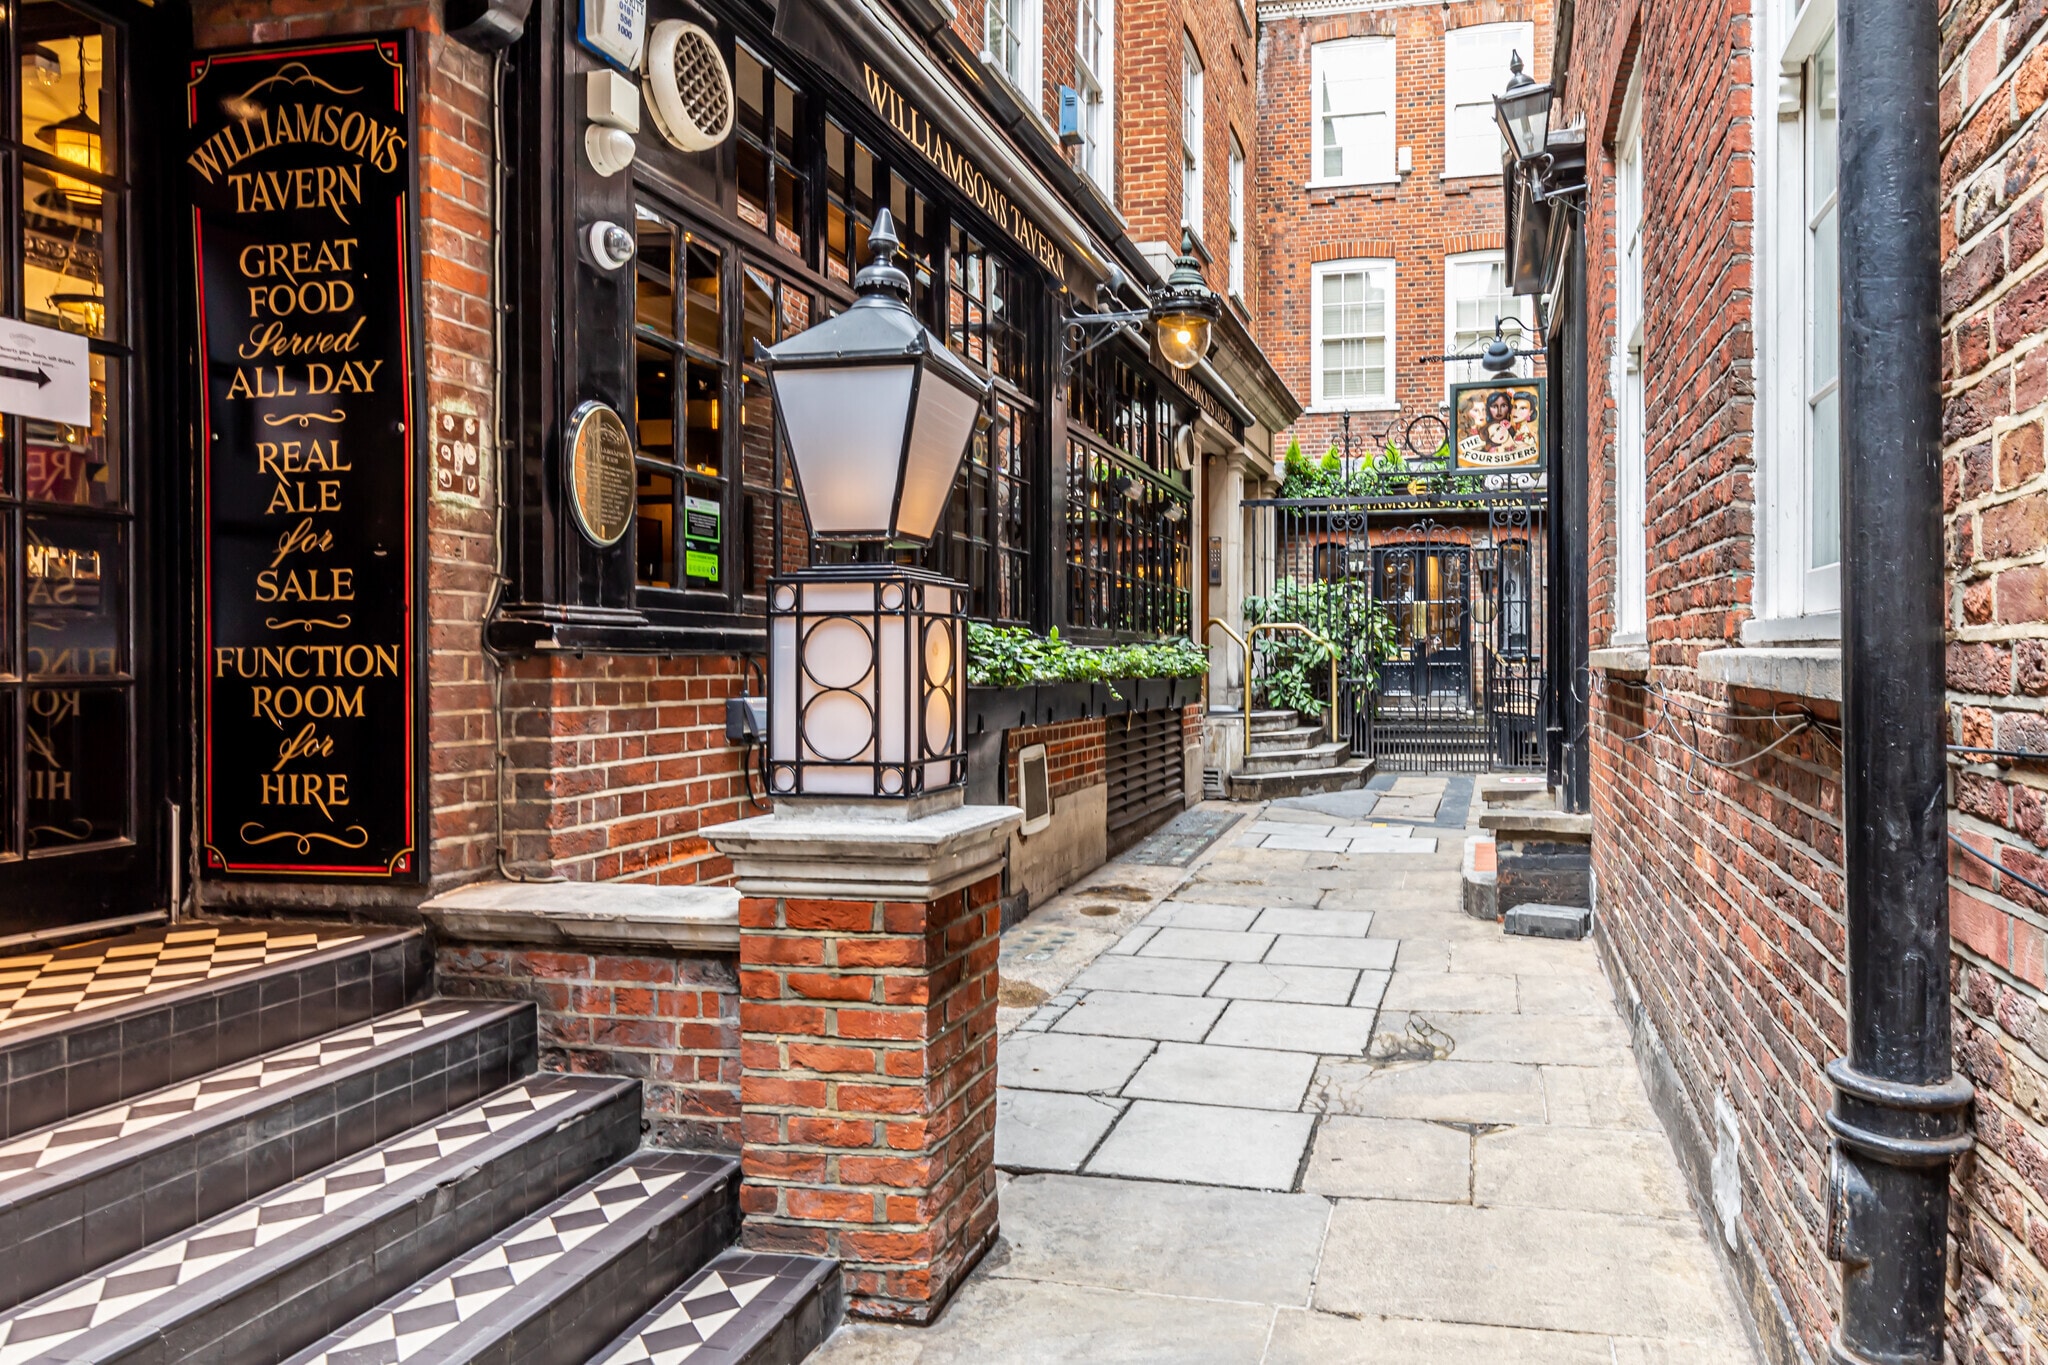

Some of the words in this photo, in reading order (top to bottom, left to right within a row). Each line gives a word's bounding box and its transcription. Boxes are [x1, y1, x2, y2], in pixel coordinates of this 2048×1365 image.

[617, 23, 632, 40] 1000
[186, 102, 408, 185] WILLIAMSON'S
[863, 61, 1008, 229] WILLIAMSONS
[1010, 204, 1066, 281] TAVERN
[227, 163, 363, 226] TAVERN
[239, 237, 359, 287] GREAT
[248, 279, 355, 318] FOOD
[238, 315, 368, 360] Served
[225, 365, 298, 400] ALL
[305, 358, 384, 395] DAY
[255, 439, 352, 488] REAL
[1461, 437, 1481, 450] THE
[1464, 451, 1493, 463] FOUR
[1494, 447, 1537, 463] SISTERS
[264, 480, 342, 515] ALE
[270, 516, 334, 569] for
[255, 568, 356, 602] SALE
[214, 644, 400, 678] FUNCTION
[251, 685, 366, 731] ROOM
[272, 721, 335, 772] for
[260, 773, 350, 823] HIRE
